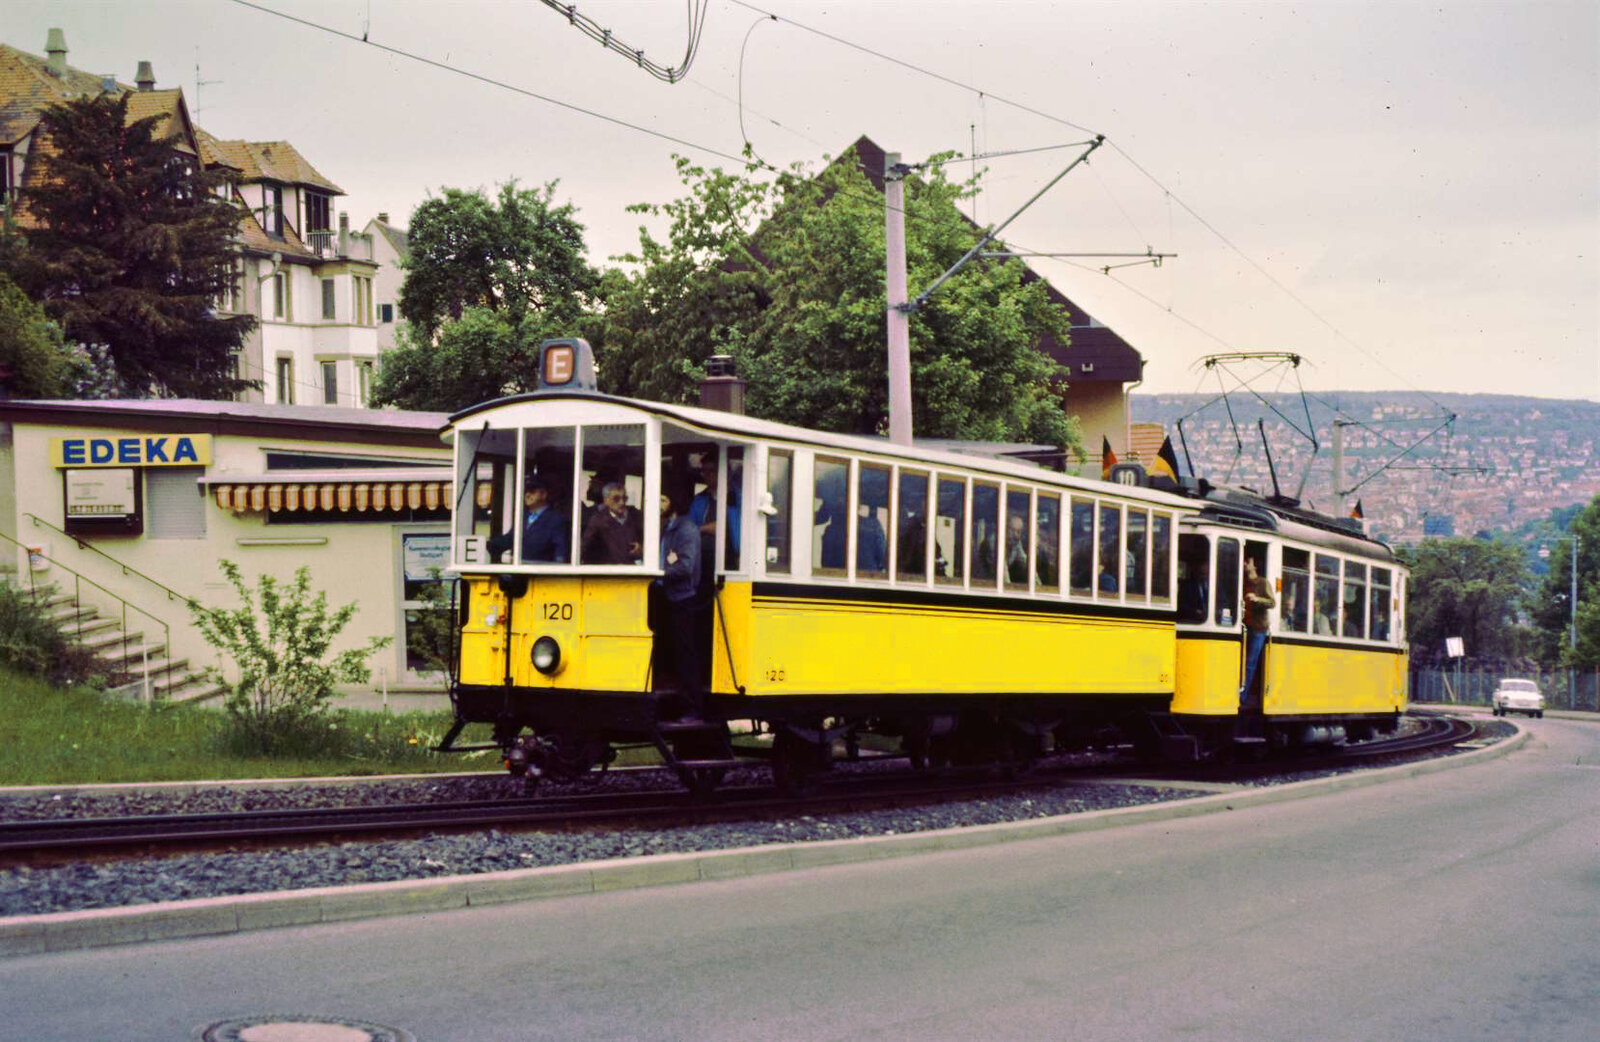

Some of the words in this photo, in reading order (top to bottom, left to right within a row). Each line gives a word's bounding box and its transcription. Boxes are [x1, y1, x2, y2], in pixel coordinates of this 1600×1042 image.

[552, 349, 570, 379] E
[62, 438, 198, 464] EDEKA
[1119, 471, 1135, 486] 10
[465, 539, 478, 562] E
[543, 603, 573, 620] 120
[766, 670, 785, 681] 120
